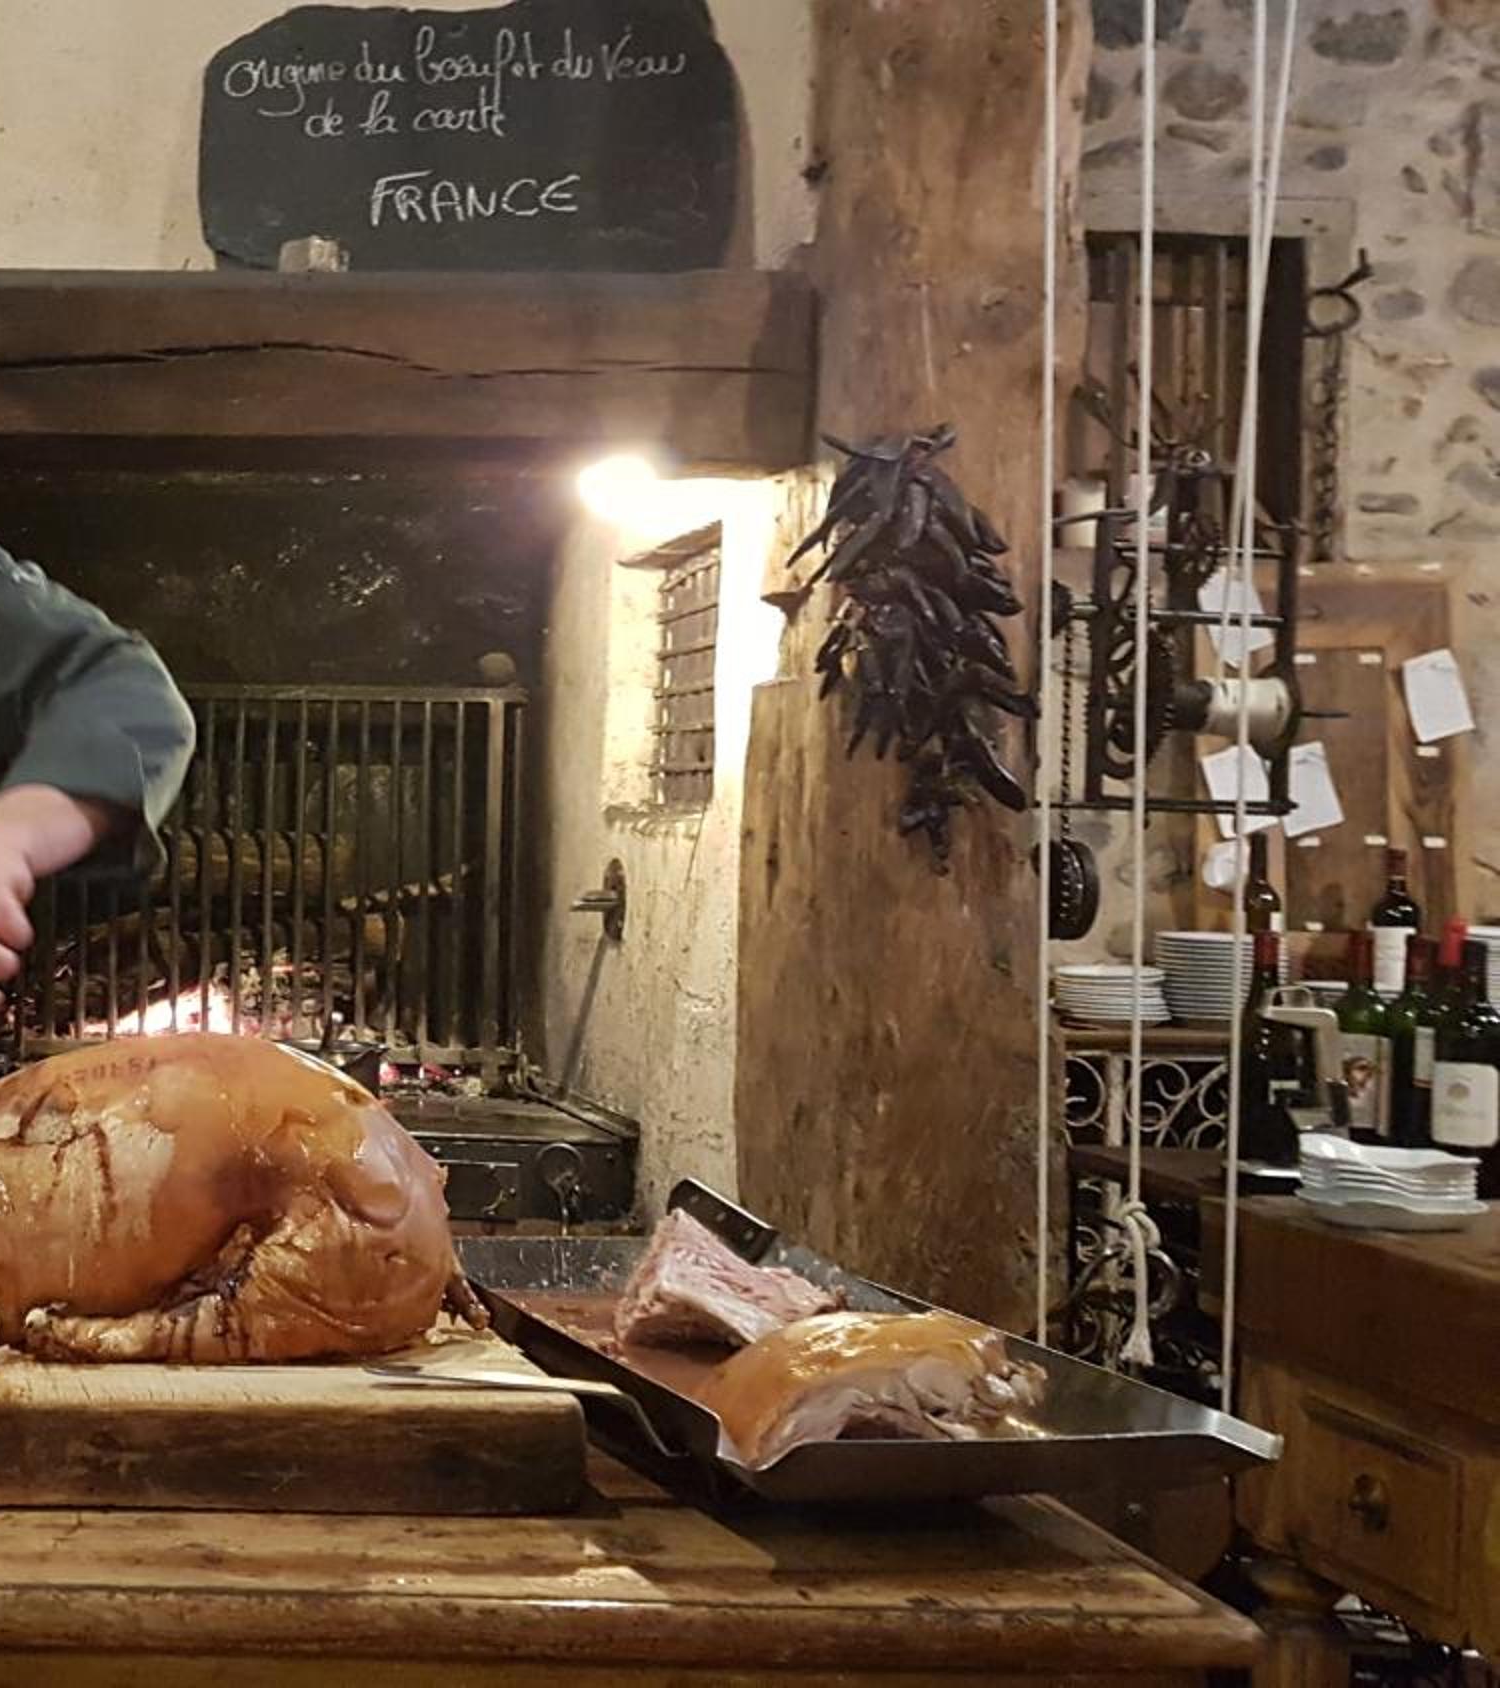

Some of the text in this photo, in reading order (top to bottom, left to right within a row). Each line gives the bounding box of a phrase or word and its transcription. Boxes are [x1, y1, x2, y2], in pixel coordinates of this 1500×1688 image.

[223, 55, 346, 116] Origine
[355, 40, 405, 82] du
[511, 31, 544, 79] et
[552, 27, 593, 79] du
[304, 85, 506, 137] de la carte
[370, 169, 581, 226] FRANCE
